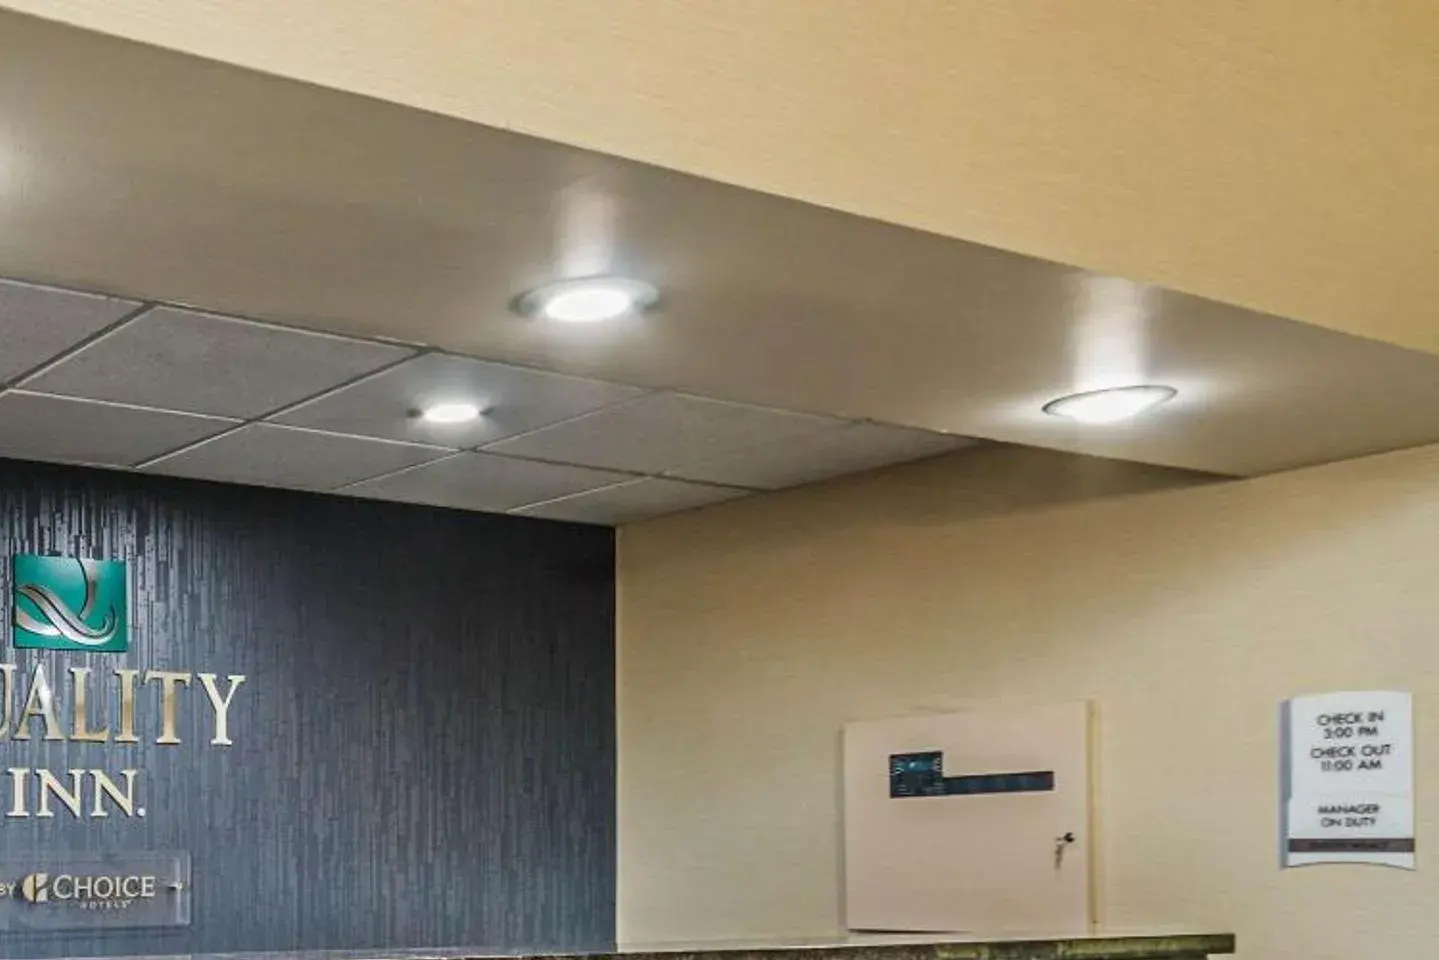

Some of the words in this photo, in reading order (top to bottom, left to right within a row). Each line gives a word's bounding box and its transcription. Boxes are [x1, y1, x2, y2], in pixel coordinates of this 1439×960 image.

[1317, 712, 1362, 726] CHECK
[1368, 710, 1384, 722] IN
[1358, 726, 1378, 736] PM
[1310, 746, 1355, 759] CHECK
[1361, 744, 1391, 757] OUT
[1321, 760, 1353, 772] 11:00
[1358, 760, 1382, 770] AM
[1318, 804, 1380, 815] MANAGER
[1345, 817, 1376, 828] DUTY
[53, 874, 156, 899] CHOICE
